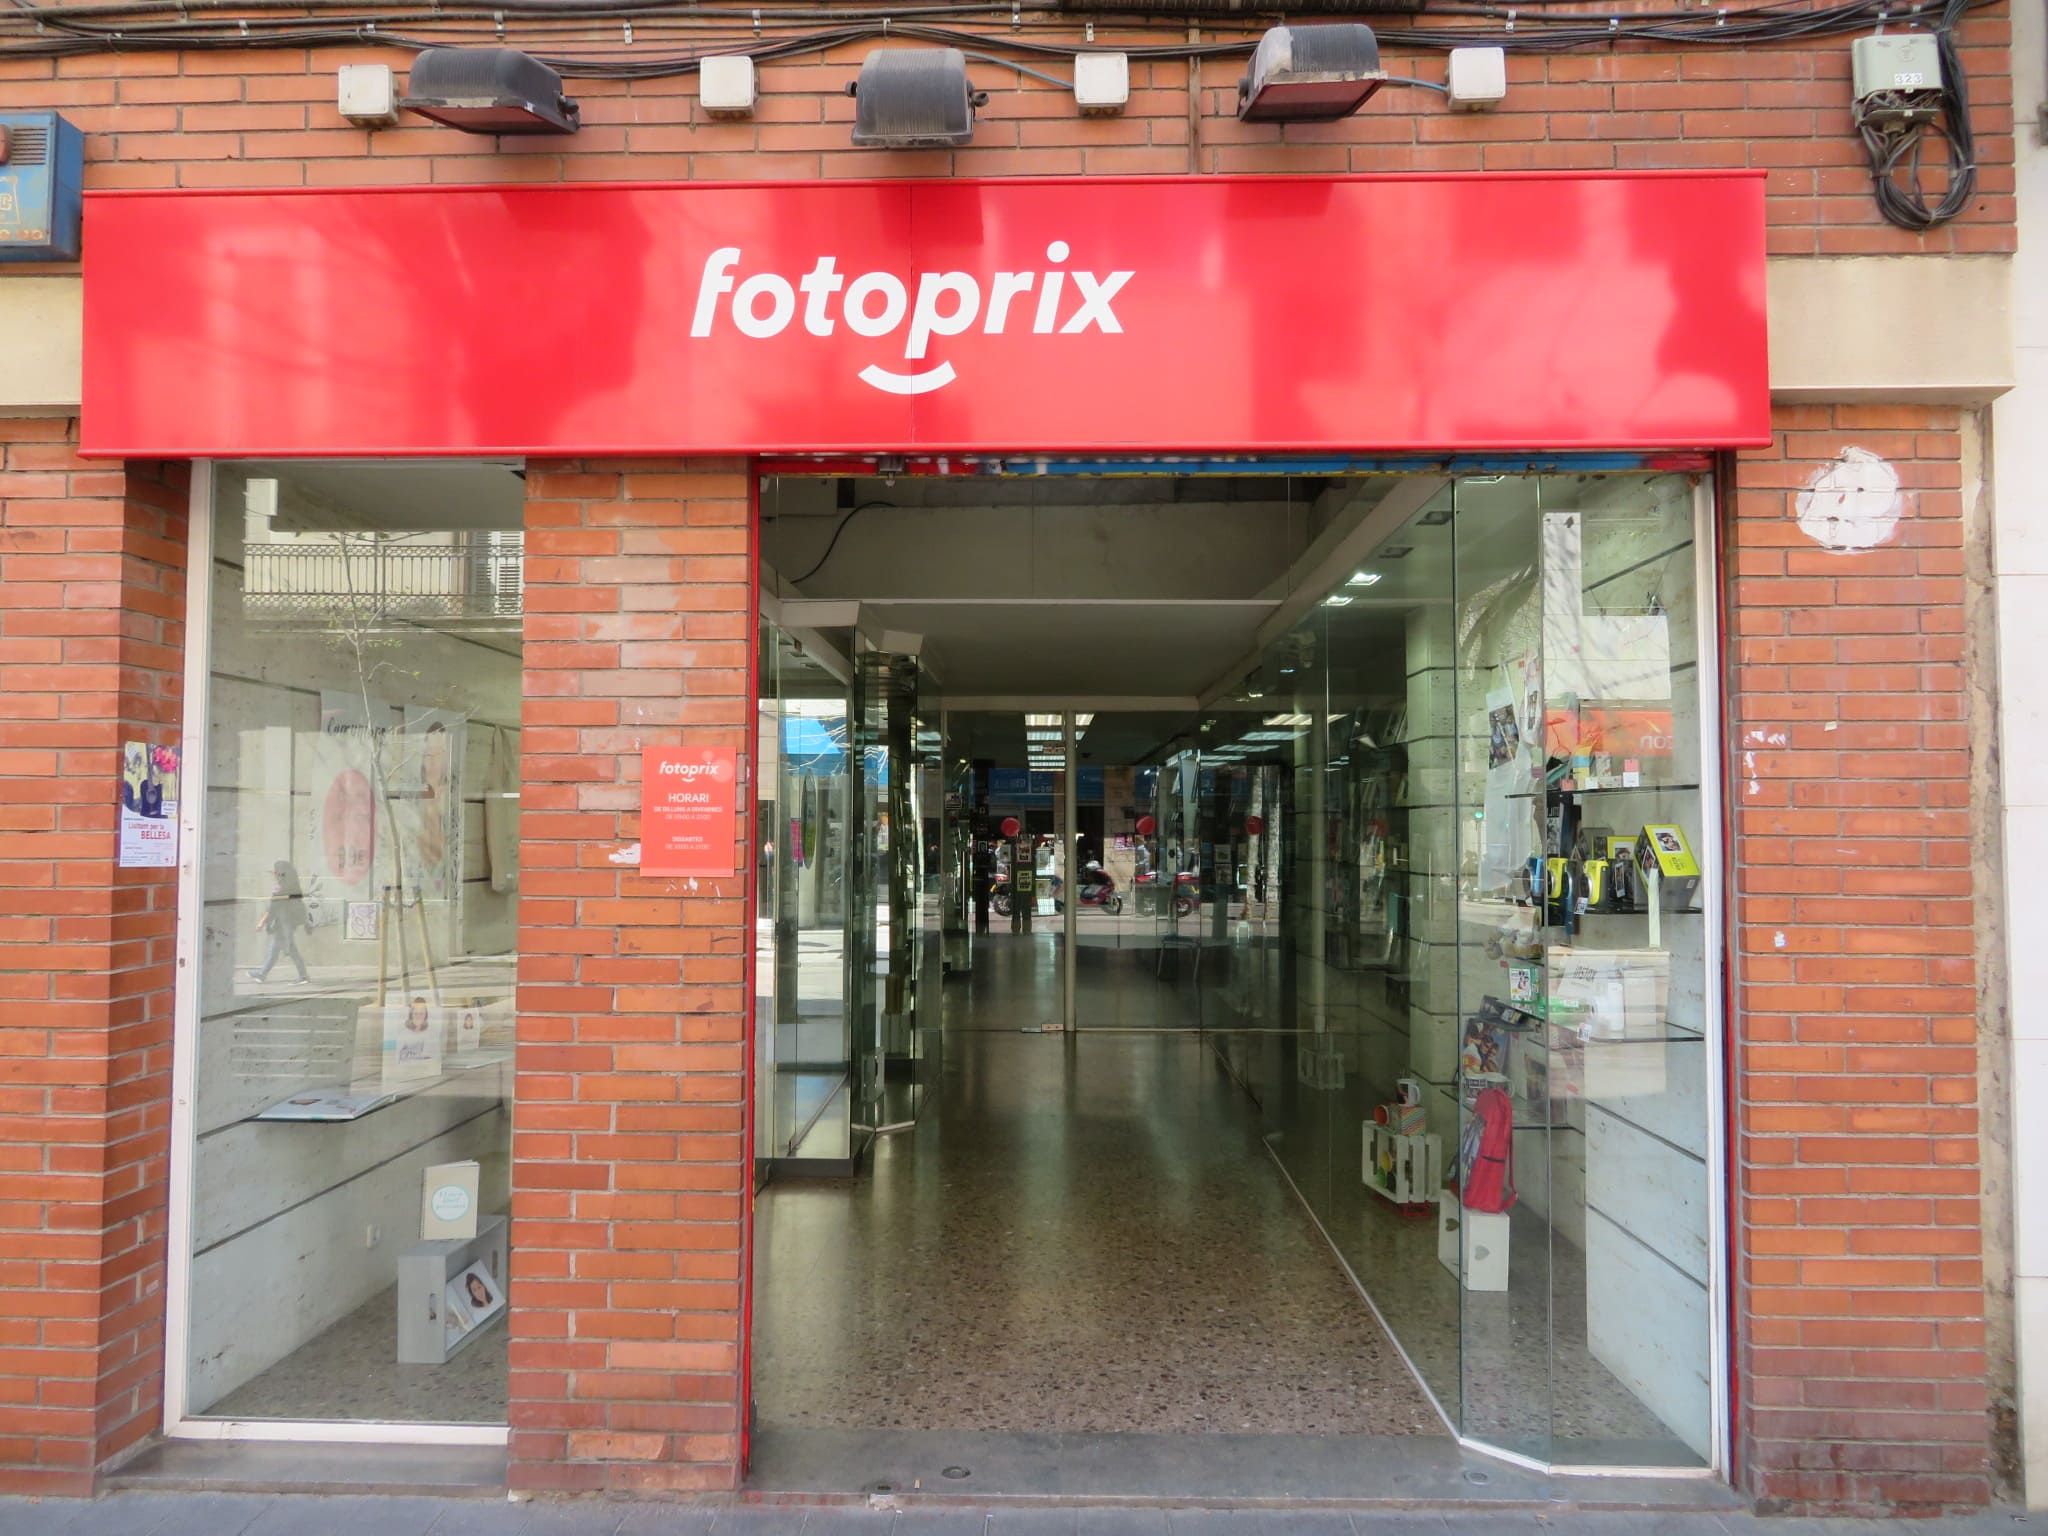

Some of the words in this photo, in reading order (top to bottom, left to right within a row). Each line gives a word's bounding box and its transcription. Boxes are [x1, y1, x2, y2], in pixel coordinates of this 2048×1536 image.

[690, 240, 1136, 360] fotoprix
[659, 760, 719, 778] fotoprix
[668, 793, 709, 803] HORARI
[140, 830, 172, 840] BELLESA
